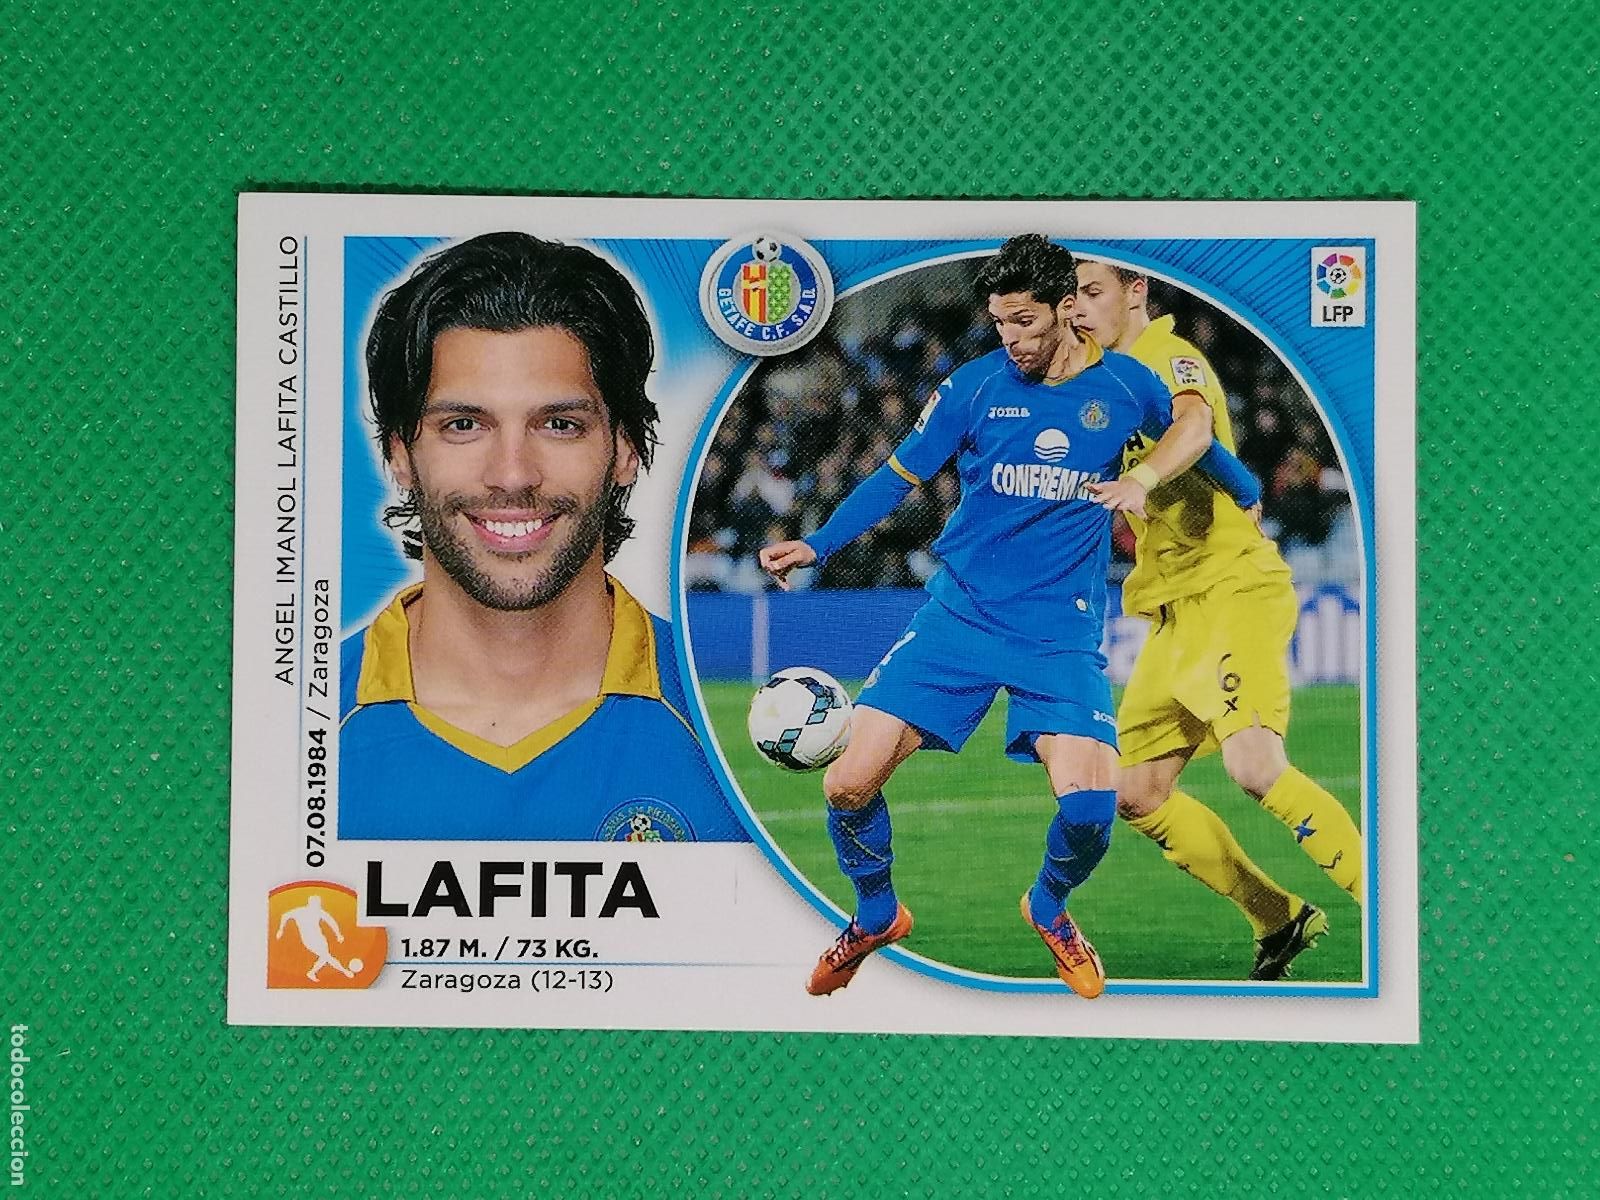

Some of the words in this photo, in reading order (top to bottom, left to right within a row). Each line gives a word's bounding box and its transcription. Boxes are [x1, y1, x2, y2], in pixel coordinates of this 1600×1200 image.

[278, 236, 299, 365] CASTILLO
[718, 287, 756, 337] GETAFE
[761, 323, 790, 340] C.F.
[1322, 305, 1354, 323] LFP
[277, 374, 298, 468] LAFITA
[276, 477, 297, 583] IMANOL
[274, 593, 295, 686] ANGEL
[308, 579, 333, 698] Zaragoza
[305, 706, 331, 721] /
[306, 728, 327, 868] 07.08.1984
[365, 860, 661, 919] LAFITA
[400, 938, 451, 958] 1.87
[459, 938, 487, 958] M.
[494, 936, 510, 961] /
[517, 939, 547, 958] 73
[555, 939, 599, 958] KG.
[401, 969, 521, 993] Zaragoza
[531, 969, 614, 993] (12-13)
